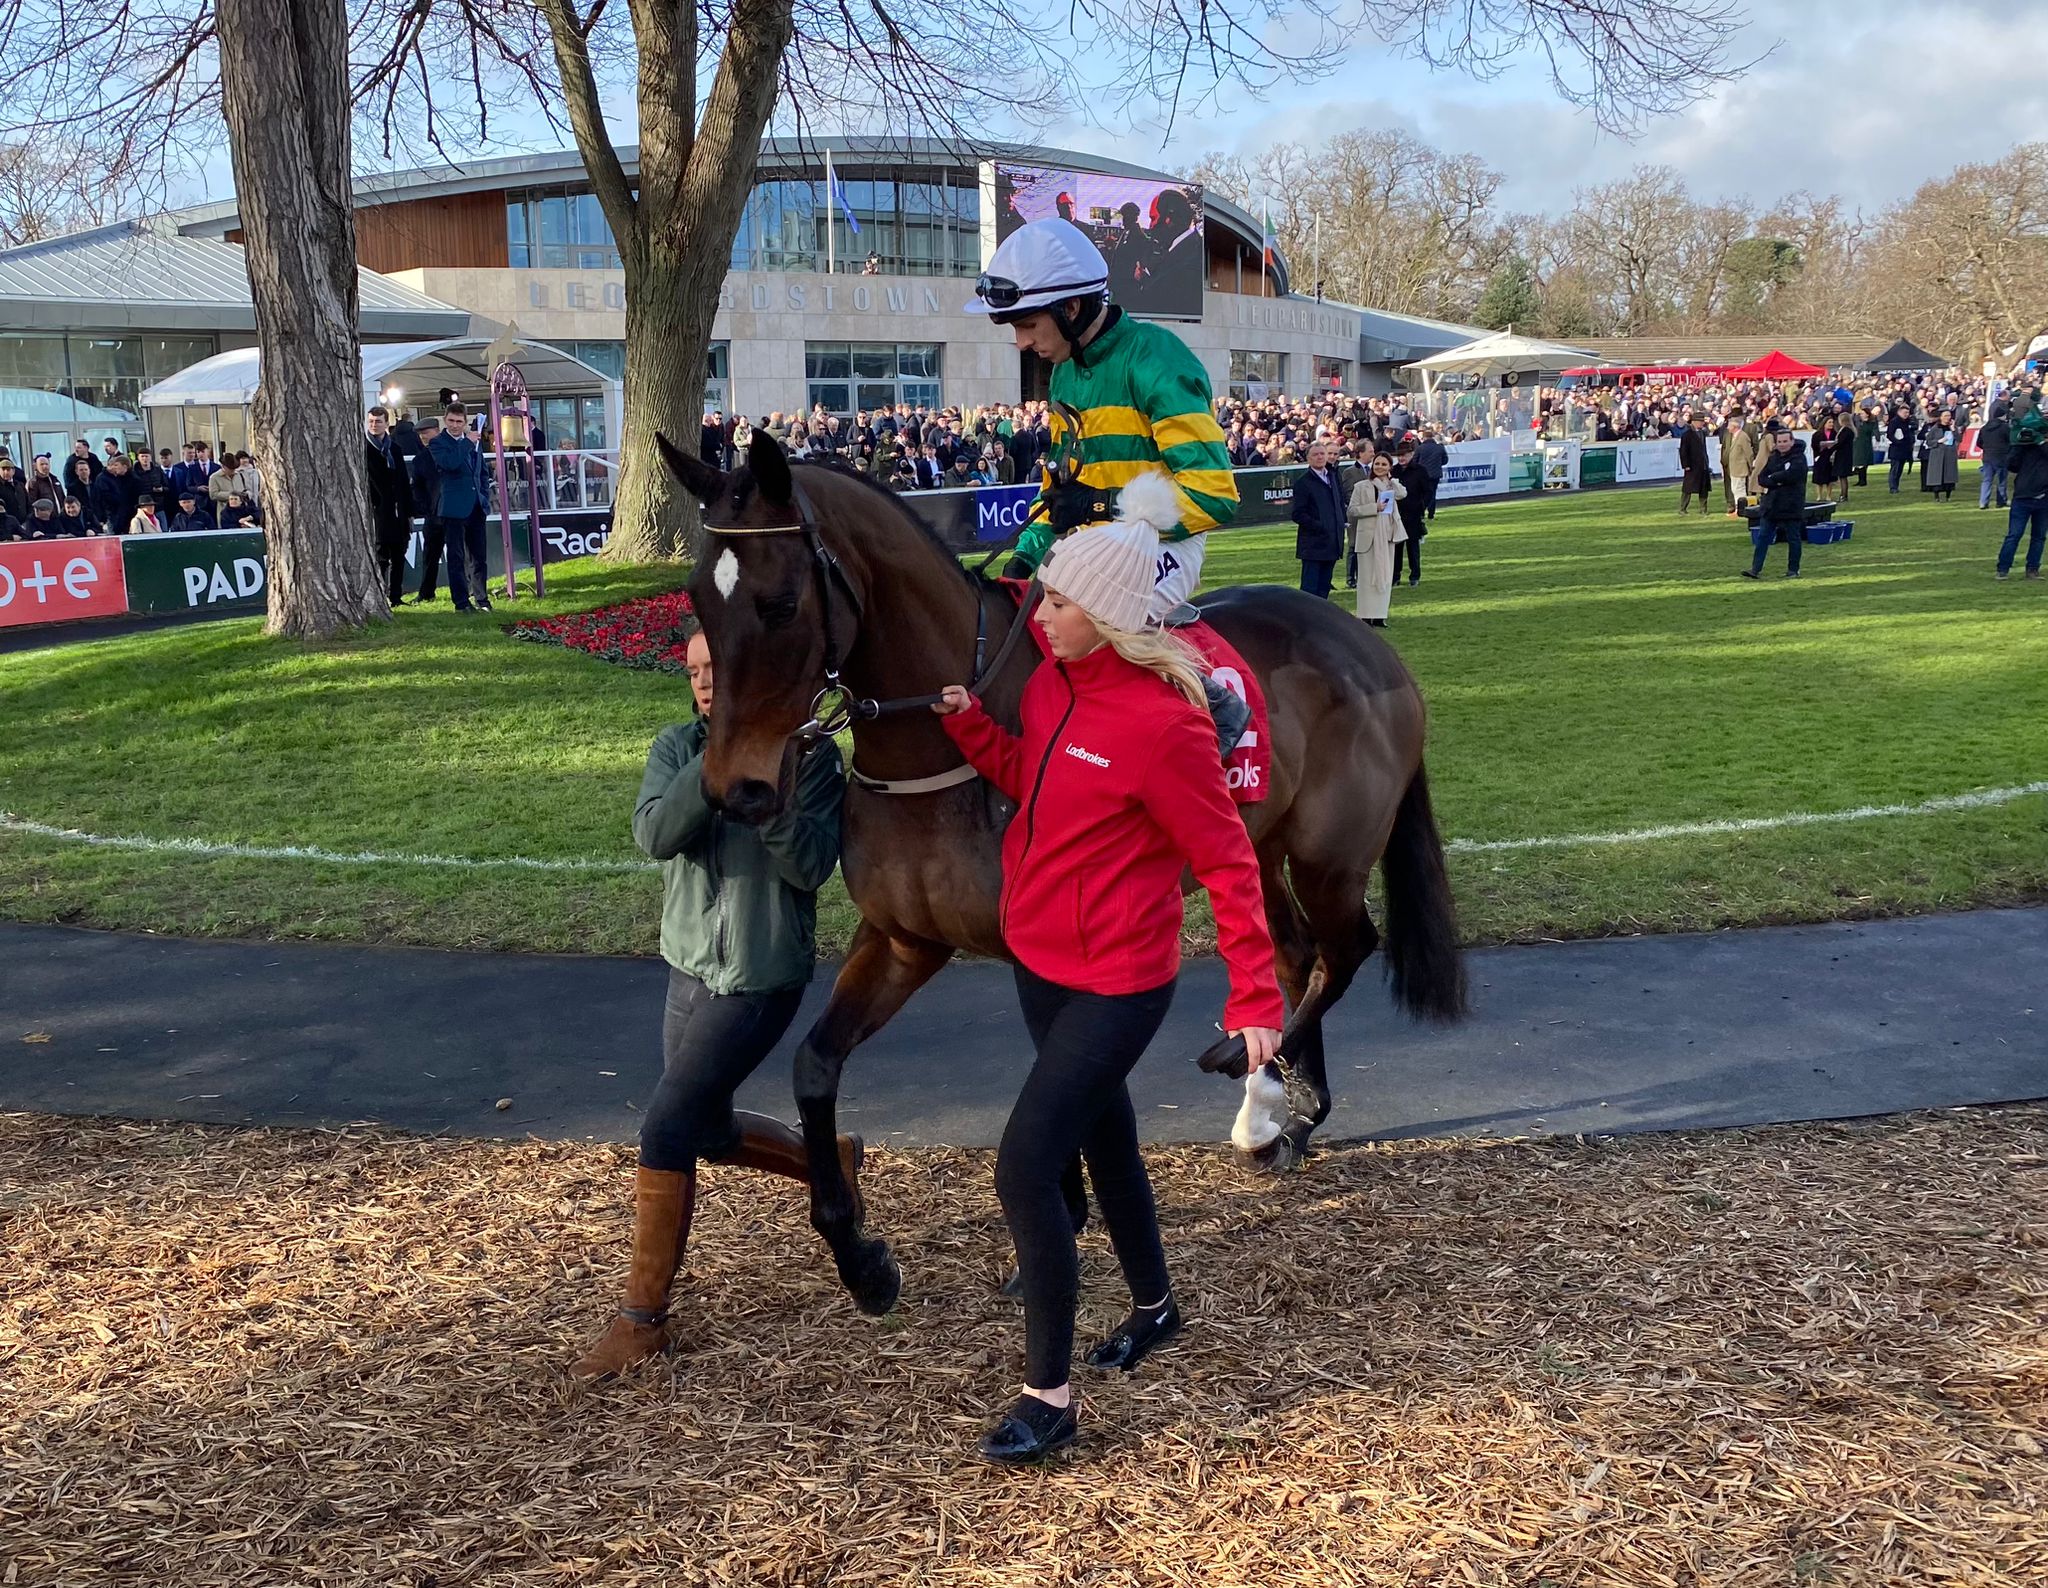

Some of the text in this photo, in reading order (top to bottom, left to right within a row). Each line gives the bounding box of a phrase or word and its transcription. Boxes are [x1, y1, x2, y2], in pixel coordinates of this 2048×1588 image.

[529, 280, 941, 313] LEORDSTOWN
[1236, 303, 1354, 339] LEOPARDSTOWN
[1441, 467, 1493, 481] TALLION FARMS
[183, 556, 267, 607] PAD
[1065, 742, 1111, 768] Ladbrokes
